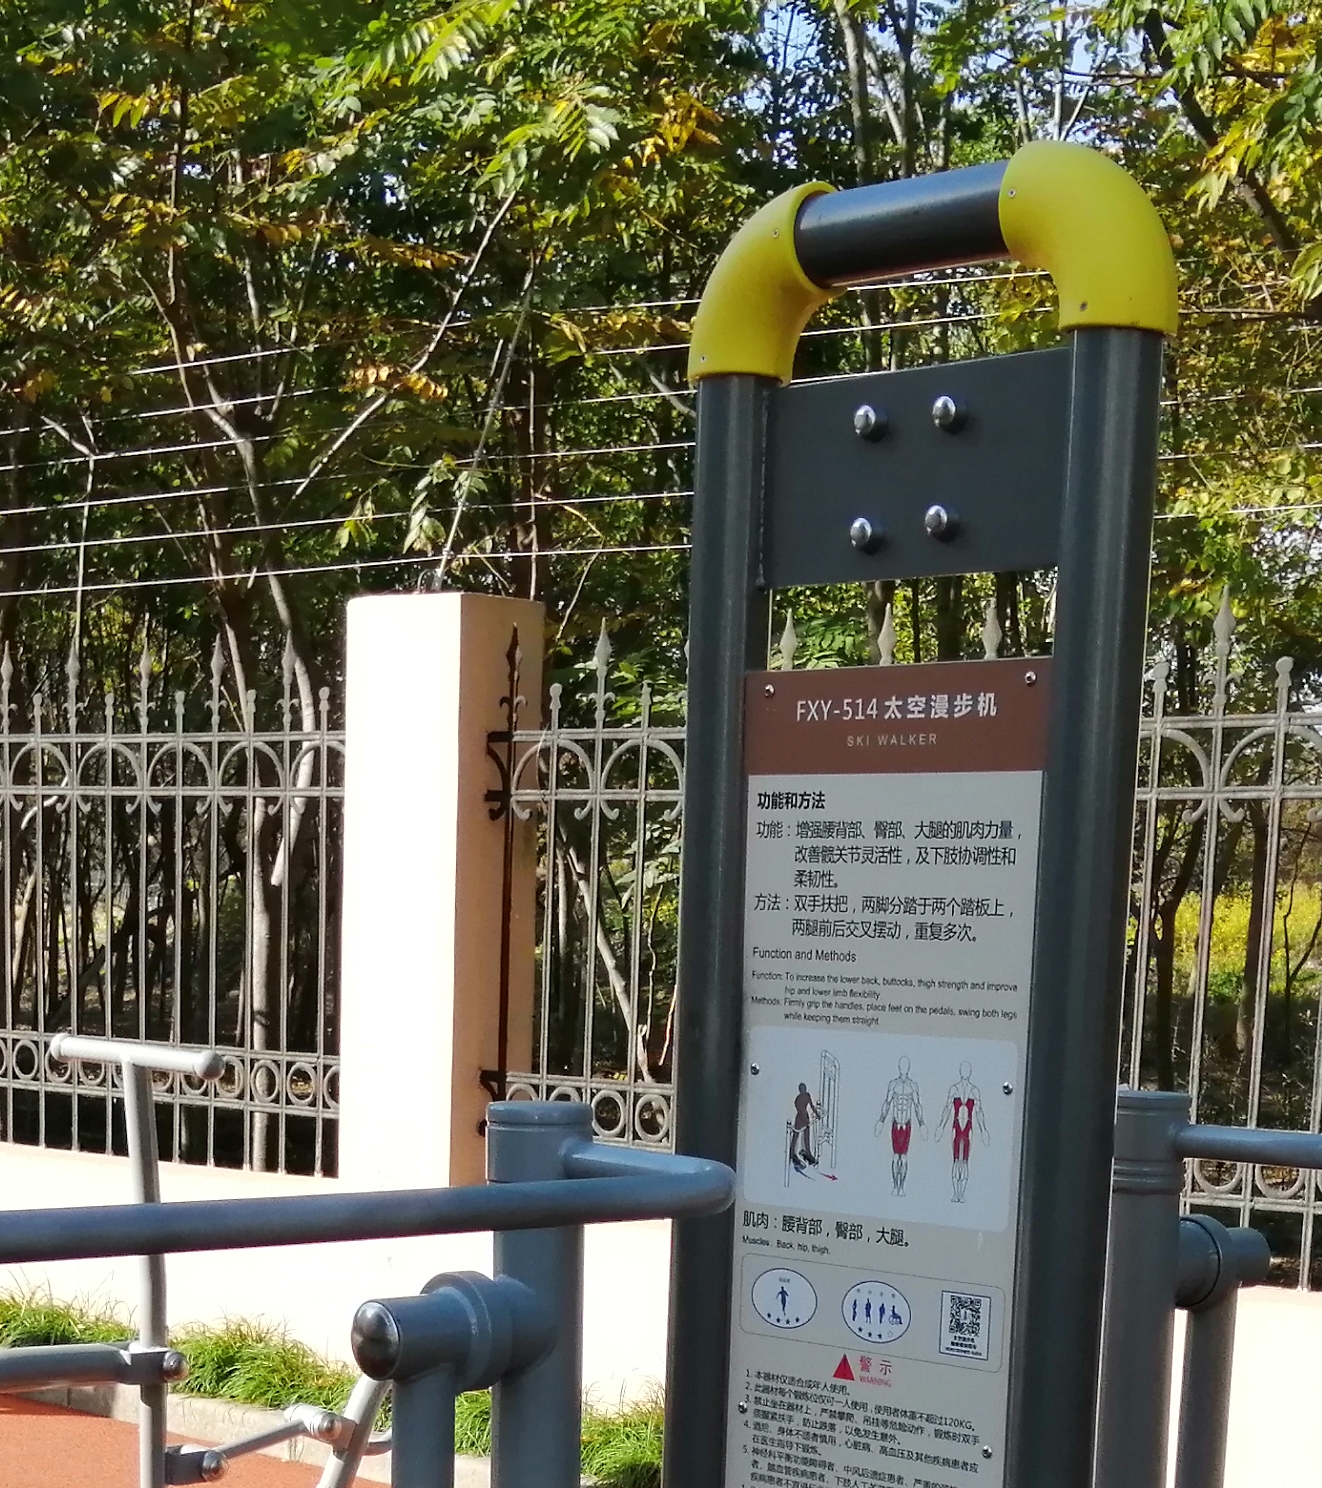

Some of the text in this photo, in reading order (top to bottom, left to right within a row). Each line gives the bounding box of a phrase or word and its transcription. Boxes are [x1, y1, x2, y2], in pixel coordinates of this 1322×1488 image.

[796, 692, 997, 722] FXY-514 太空漫步机
[846, 733, 937, 747] SKI WALKER
[757, 791, 826, 811] 功能和方法
[794, 846, 1017, 866] 改善髋关节灵活性，及下肢协调性和
[793, 869, 840, 889] 柔韧性。
[792, 919, 978, 942] 两腿前后交叉摆动，重复多次。
[752, 946, 857, 963] Function and Methods
[751, 970, 1018, 993] Function: To increase the lower back, buttocks, thigh strength and improve
[785, 985, 796, 996] hip
[797, 986, 811, 996] and
[812, 987, 831, 997] lower
[833, 988, 848, 998] limb
[783, 1012, 803, 1021] while
[803, 1013, 831, 1024] keeping
[832, 1014, 851, 1024] them
[784, 997, 806, 1008] Firmly
[806, 999, 821, 1010] grip
[822, 999, 833, 1009] the
[866, 1001, 886, 1013] place
[888, 1003, 902, 1012] feet
[903, 1005, 914, 1013] on
[915, 1005, 928, 1014] the
[928, 1006, 956, 1017] pedals,
[958, 1008, 981, 1019] swing
[982, 1009, 999, 1018] both
[1001, 1010, 1018, 1021] legs
[743, 1210, 910, 1248] 肌肉：腰背部，臀部，大腿。
[742, 1235, 773, 1247] Muscles:
[776, 1239, 796, 1251] Back,
[797, 1242, 810, 1253] hip,
[858, 1355, 893, 1376] 警示
[745, 1381, 752, 1391] 2.
[858, 1375, 892, 1388] WARNING
[743, 1419, 751, 1429] 4.
[742, 1444, 750, 1454] 5.
